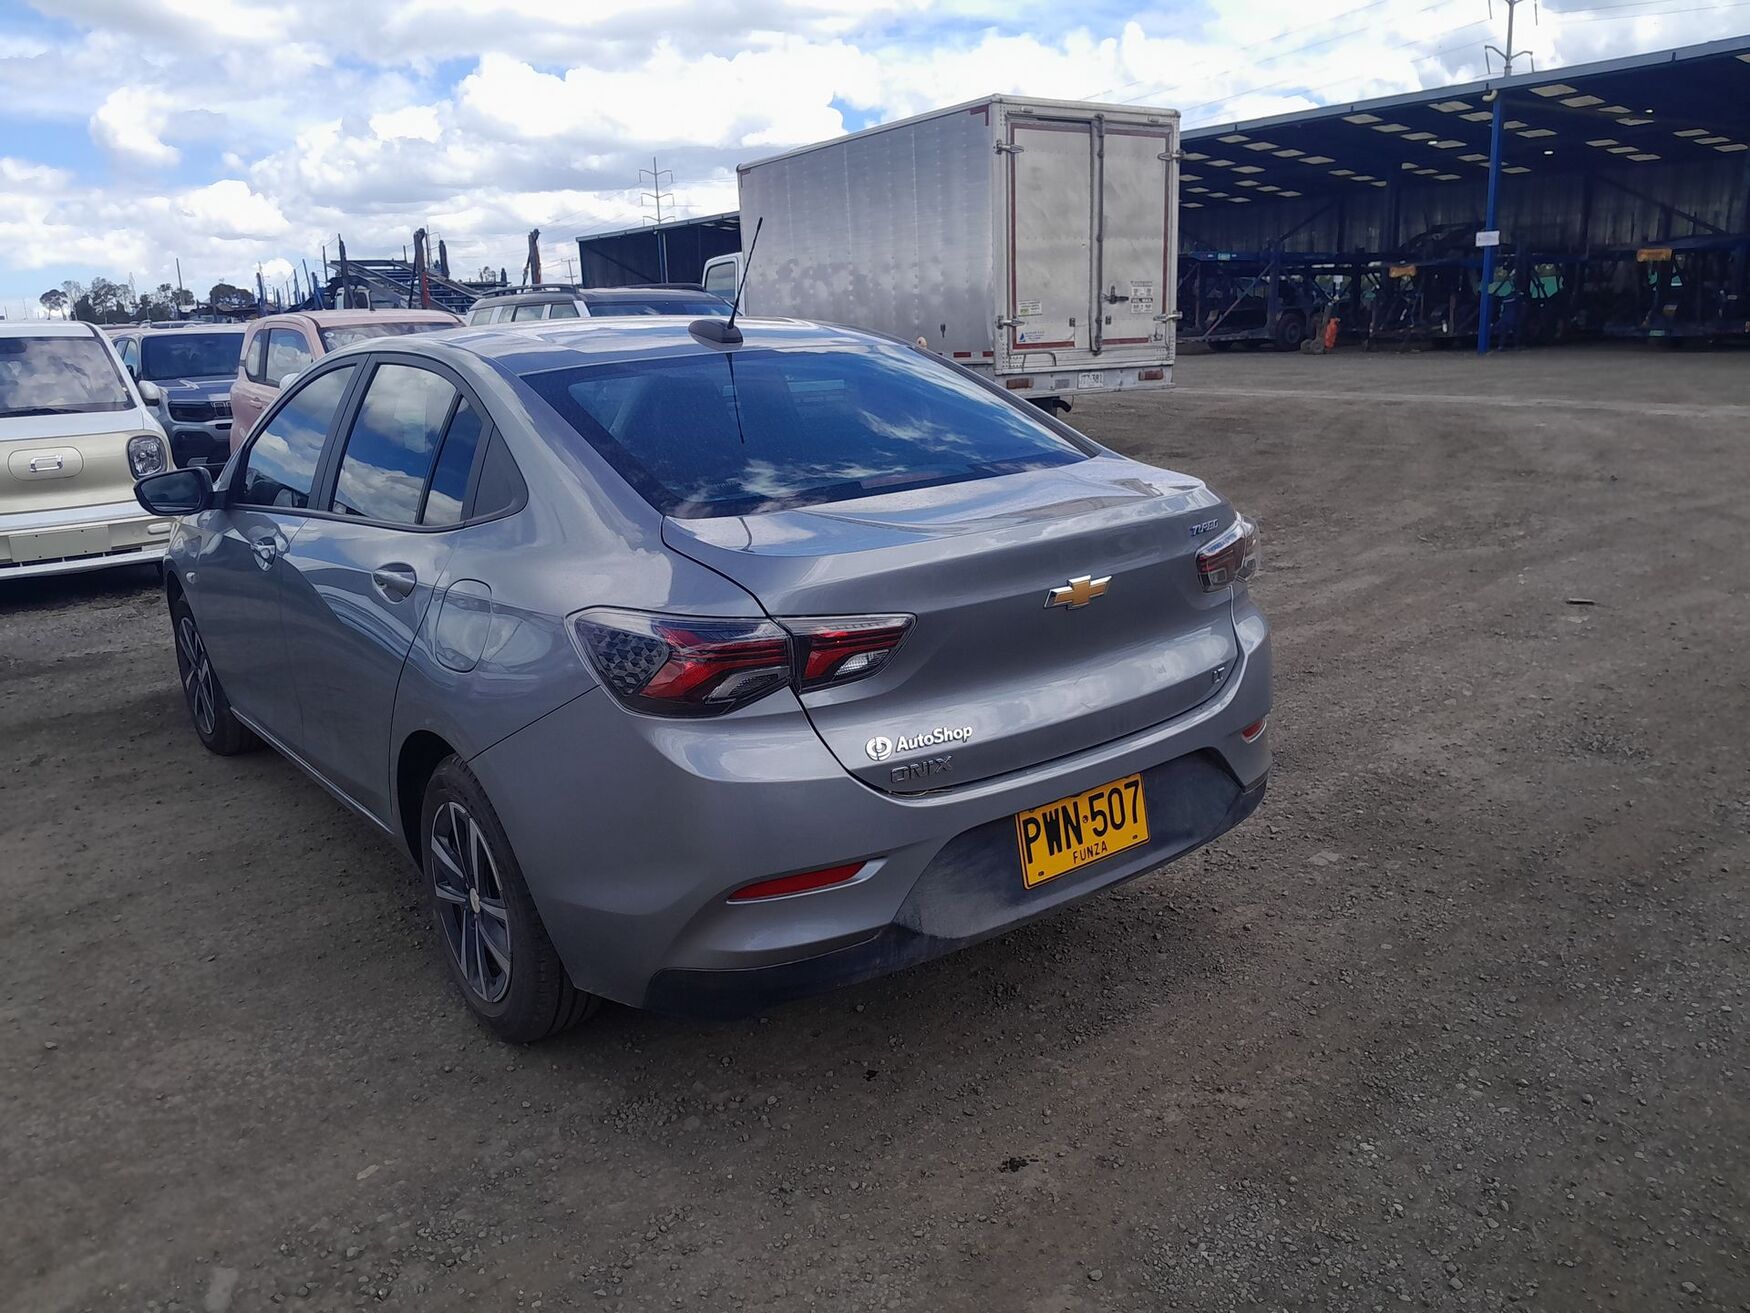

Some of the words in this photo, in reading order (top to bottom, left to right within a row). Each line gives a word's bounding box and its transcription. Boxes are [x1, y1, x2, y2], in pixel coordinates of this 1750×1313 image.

[896, 726, 973, 753] AutoShop
[891, 755, 952, 784] ONIX
[1072, 840, 1108, 865] FUNZA
